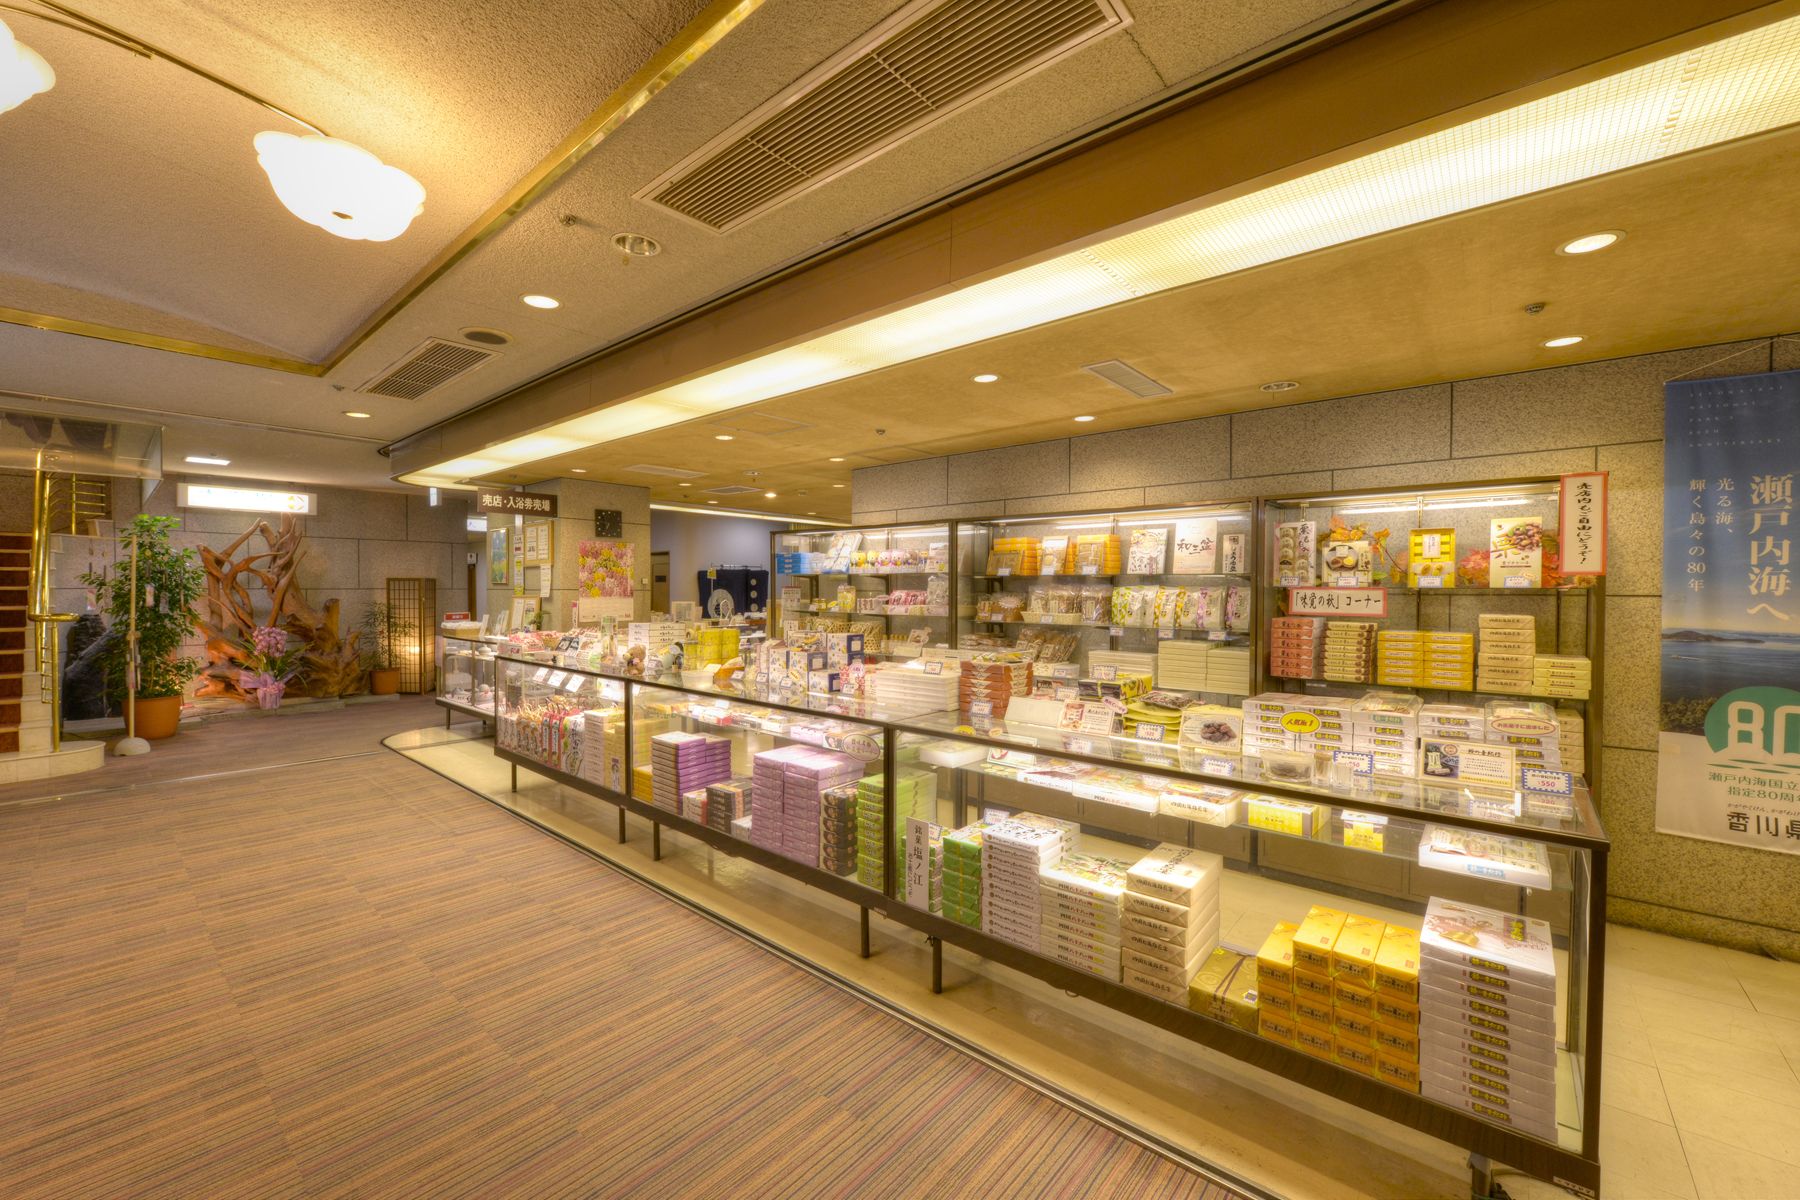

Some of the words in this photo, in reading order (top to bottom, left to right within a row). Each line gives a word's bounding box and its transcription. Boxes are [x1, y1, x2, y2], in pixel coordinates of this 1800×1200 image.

[482, 493, 551, 512] 売店・入浴券売場
[1176, 537, 1214, 555] 和三盆
[1687, 479, 1707, 593] 輝く島々の80年
[1746, 473, 1794, 621] 瀬戸内海へ
